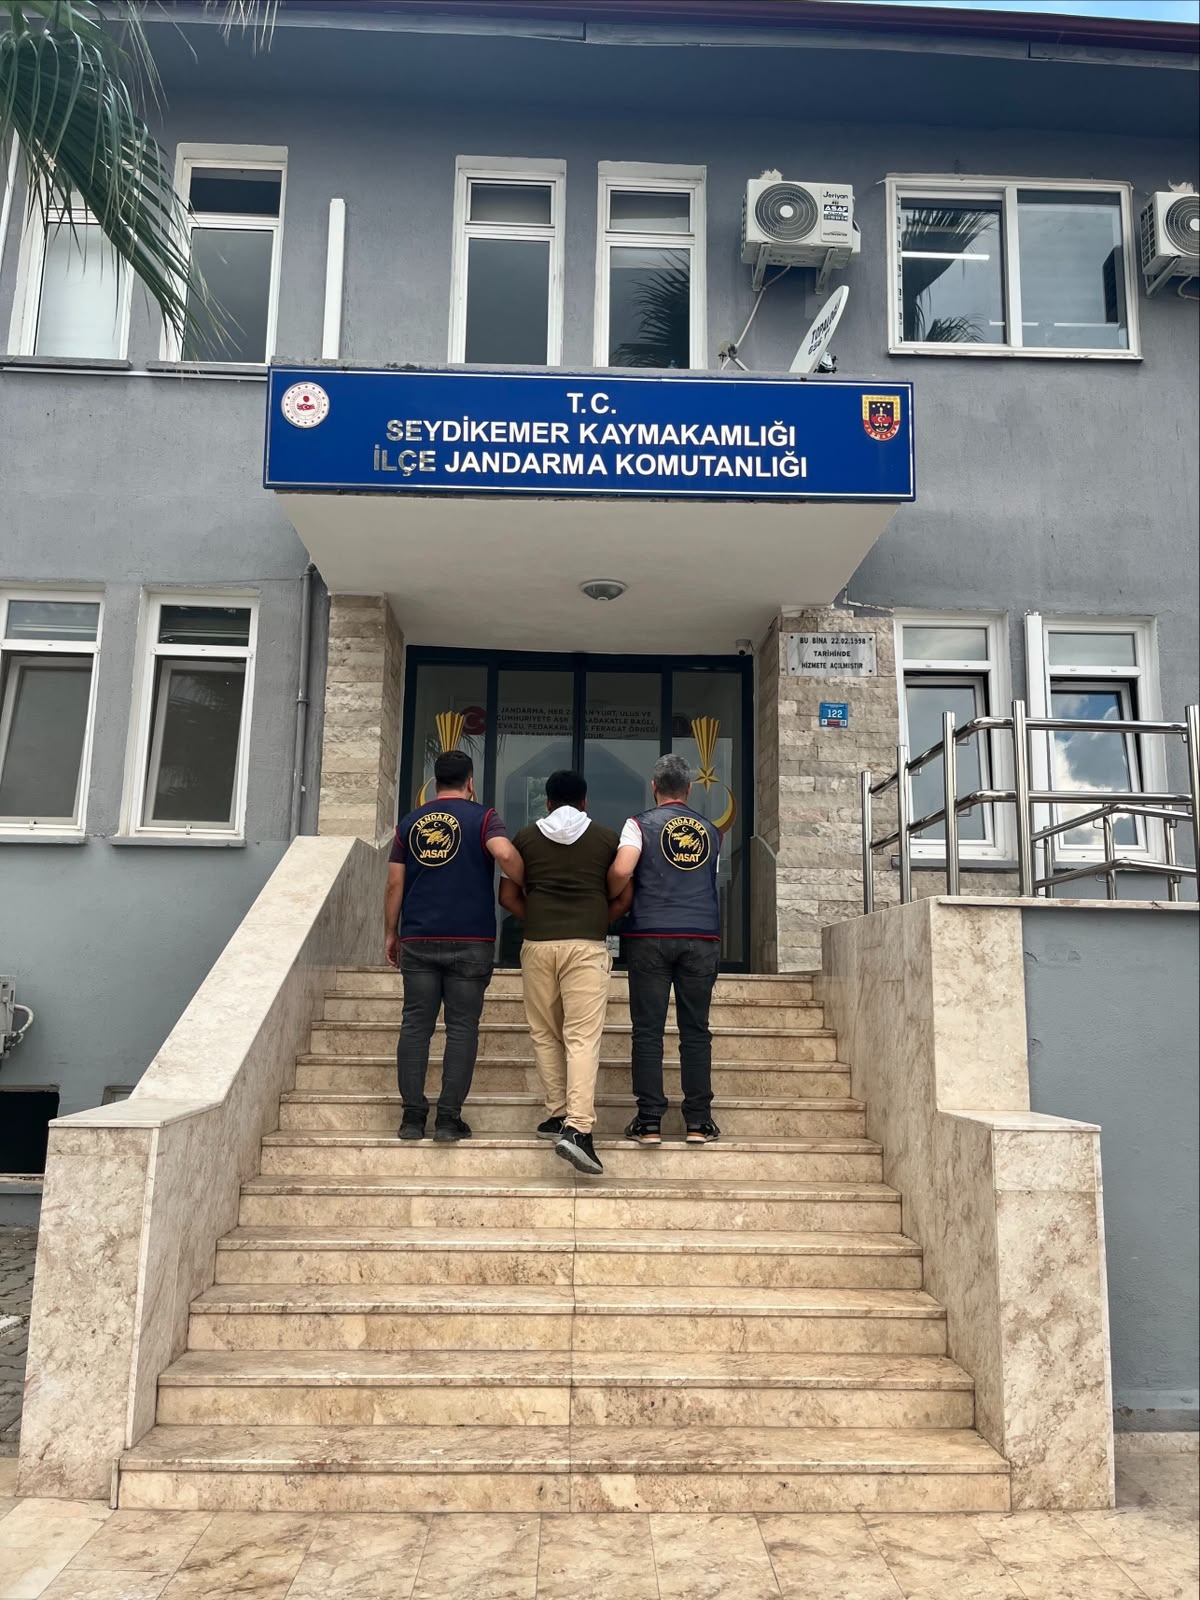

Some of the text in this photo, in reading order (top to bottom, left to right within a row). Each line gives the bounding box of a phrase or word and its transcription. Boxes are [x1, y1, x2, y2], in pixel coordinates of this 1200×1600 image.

[566, 393, 617, 414] T.C.
[386, 415, 796, 447] SEYDİKEMER KAYMAKAMLIĞI
[373, 444, 808, 478] İLÇE JANDARMA KOMUTANLIĞI
[812, 636, 827, 644] BİNA
[813, 649, 851, 657] TARİHİNDE
[801, 661, 827, 669] HİZMETE
[827, 709, 843, 718] 122
[416, 814, 458, 830] JANDARMA
[665, 818, 706, 836] JANDARMA
[420, 850, 449, 858] JASAT
[673, 853, 700, 862] JASAT
